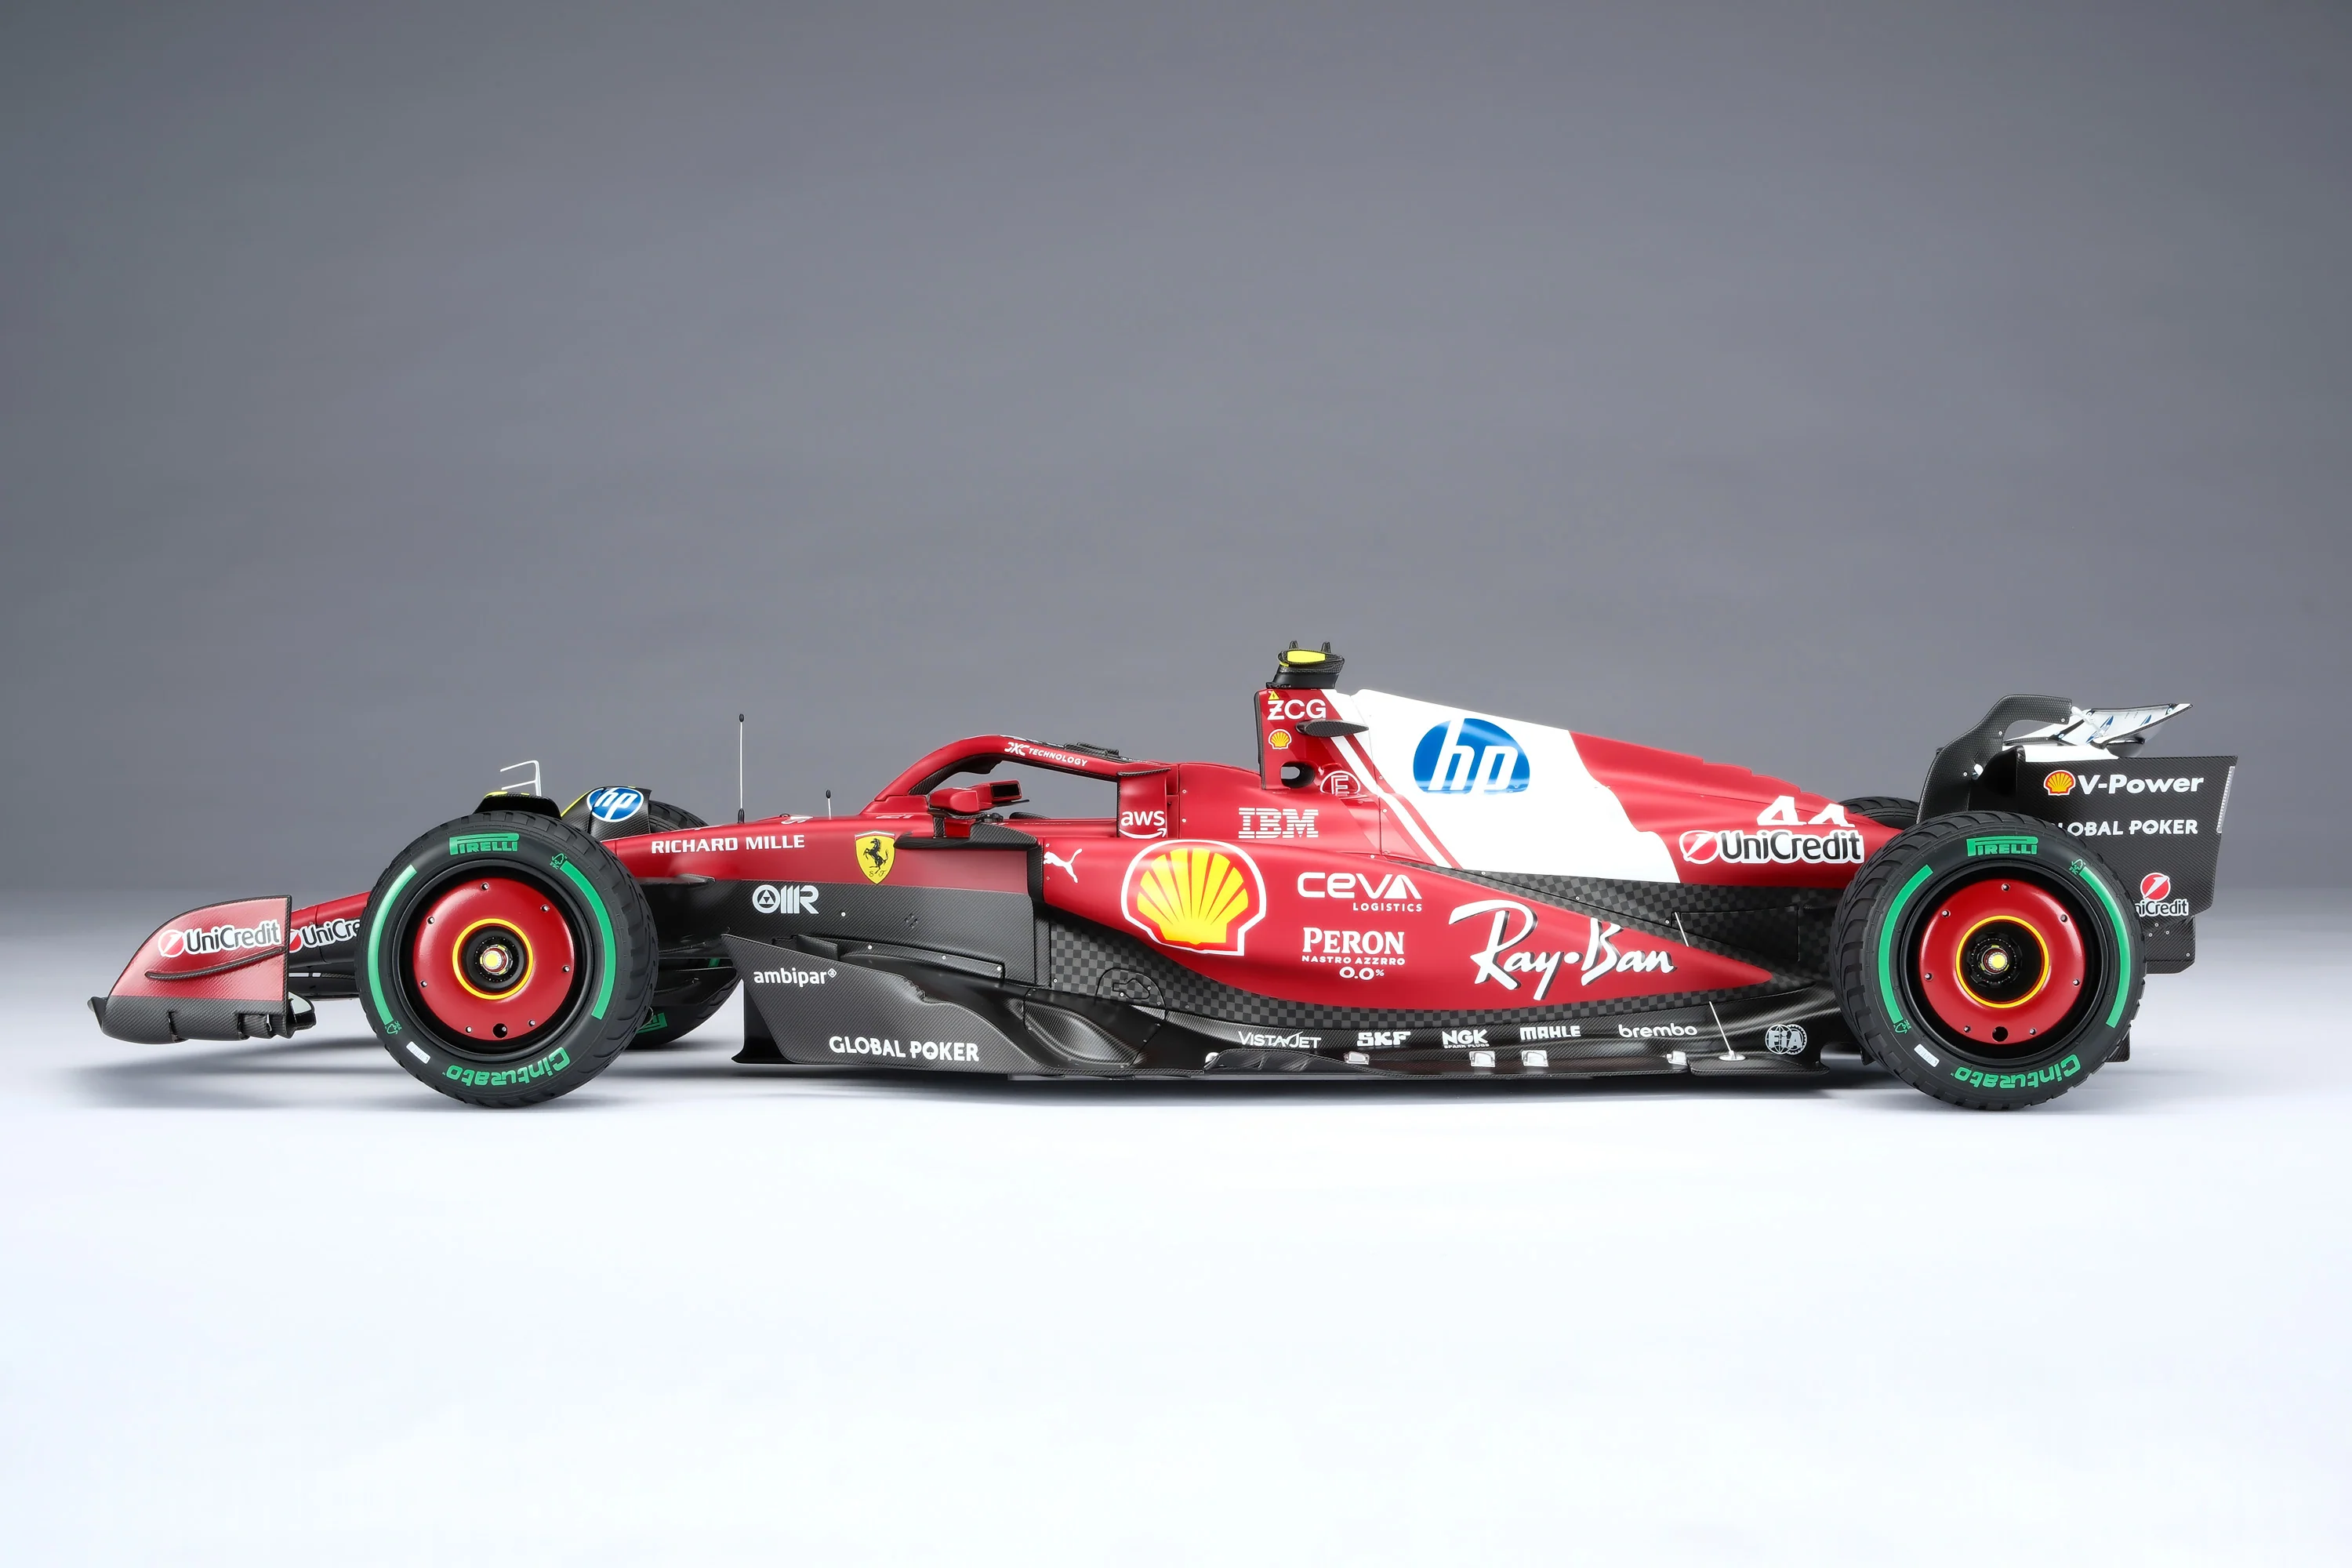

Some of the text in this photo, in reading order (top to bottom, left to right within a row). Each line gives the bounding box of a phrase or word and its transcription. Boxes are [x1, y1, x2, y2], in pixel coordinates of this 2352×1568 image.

[1027, 747, 1088, 767] TECHNOLOGY
[1427, 718, 1519, 795] hp
[2078, 774, 2205, 795] V-Power
[596, 786, 639, 821] hp
[1756, 795, 1856, 827] 44
[1120, 810, 1166, 827] aws
[1238, 807, 1319, 839] IBM
[2058, 819, 2198, 837] OBAL POKER
[448, 833, 520, 855] PIRELLI
[651, 834, 805, 854] RICHARD MILLE
[1720, 831, 1862, 860] UniCredit
[1965, 835, 2038, 857] PIRELLI
[1352, 902, 1423, 913] LOGISTICS
[2134, 900, 2187, 915] niCredit
[186, 923, 280, 953] UniCredit
[301, 920, 361, 946] UniCre
[1301, 927, 1405, 955] PERON
[1301, 955, 1406, 966] NASTRO AZZRRO
[753, 967, 828, 988] ambipar
[1339, 966, 1385, 980] 0.0%
[1356, 1031, 1411, 1047] SKF
[1442, 1029, 1489, 1045] NGK
[1519, 1025, 1582, 1041] MAHLE
[1617, 1023, 1698, 1038] brembo
[829, 1036, 980, 1062] GLOBAL POKER
[445, 1047, 571, 1087] Cinturato
[1954, 1054, 2082, 1089] Cinturato
